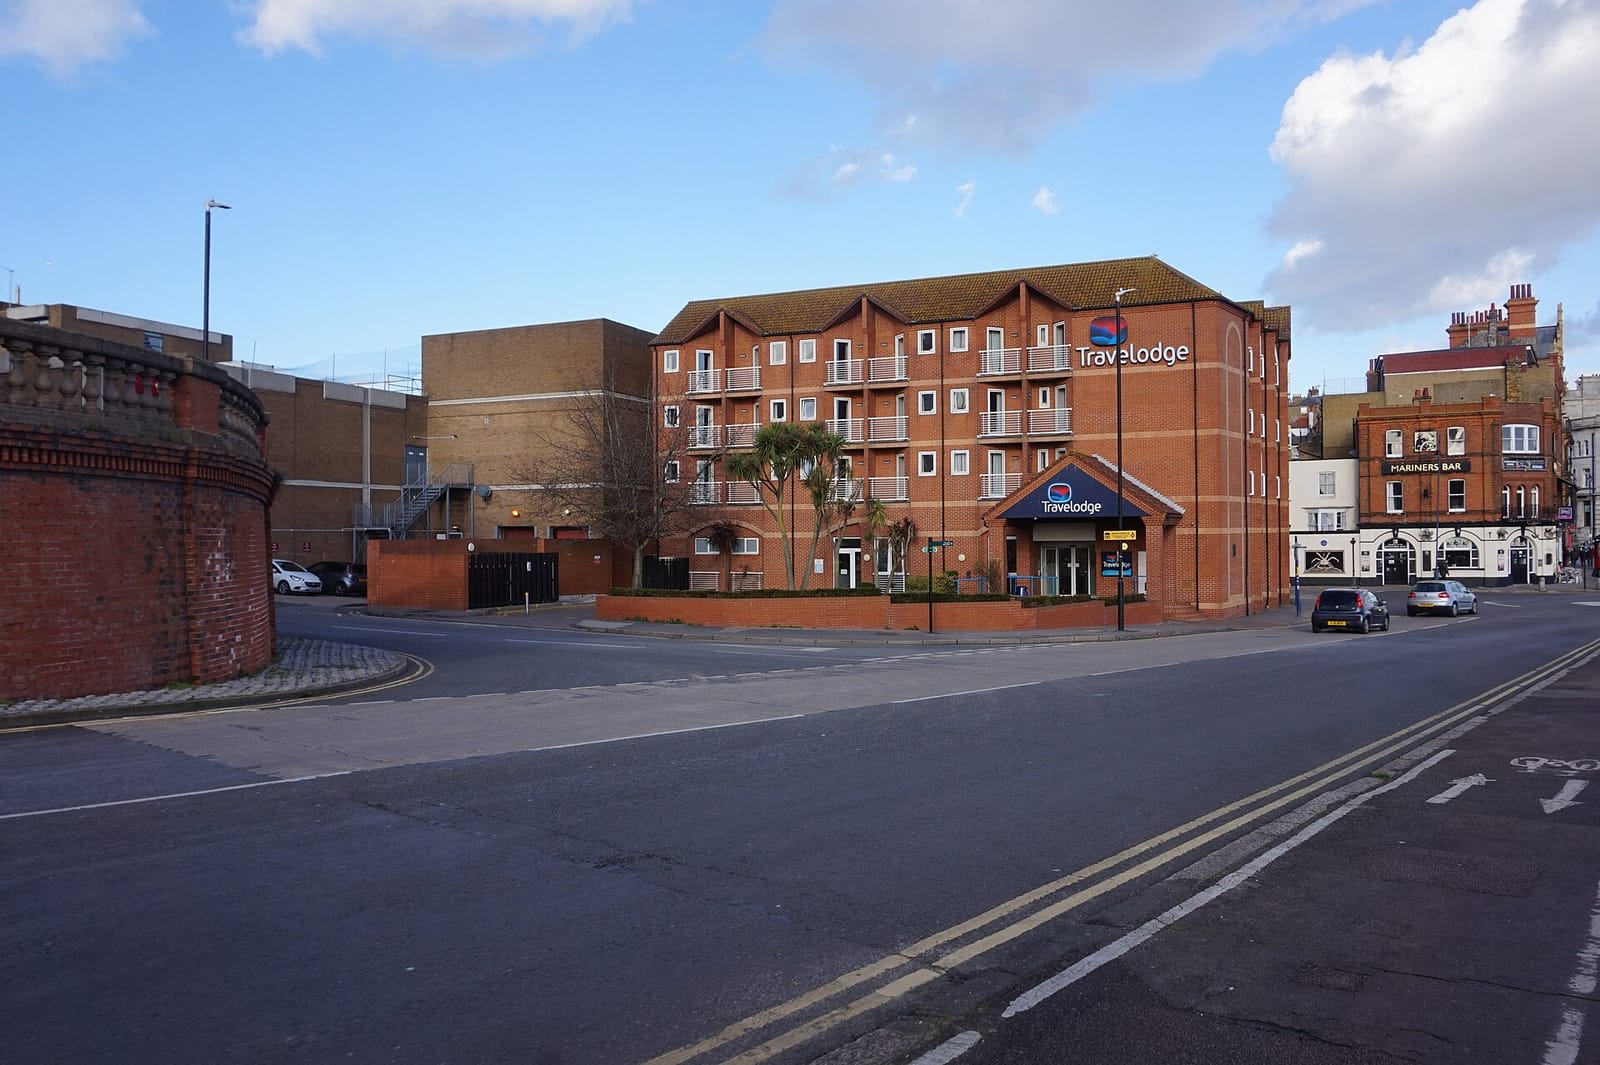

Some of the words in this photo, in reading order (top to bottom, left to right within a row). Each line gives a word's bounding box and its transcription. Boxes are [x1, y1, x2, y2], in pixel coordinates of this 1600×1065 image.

[1076, 341, 1189, 367] Travelodge
[1391, 463, 1439, 472] MARINERS
[1442, 462, 1461, 471] BAR
[1041, 500, 1102, 515] Travelodge
